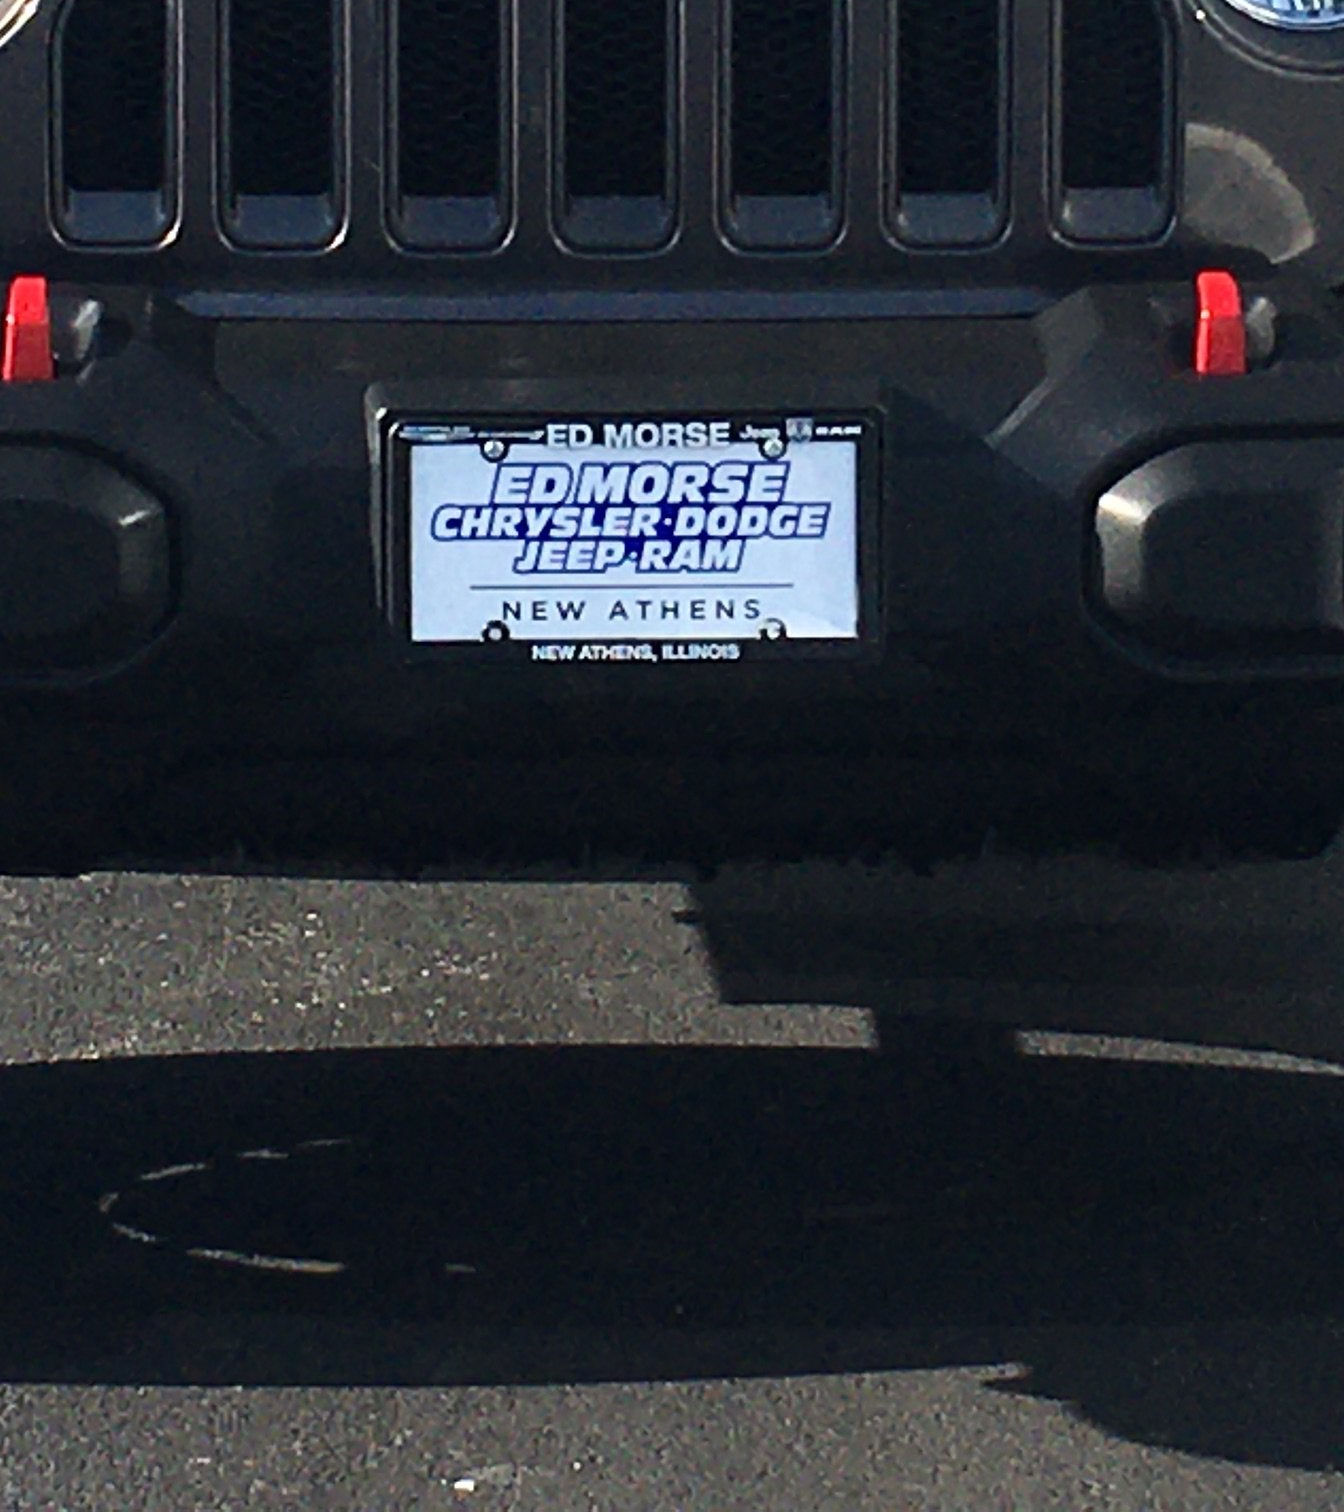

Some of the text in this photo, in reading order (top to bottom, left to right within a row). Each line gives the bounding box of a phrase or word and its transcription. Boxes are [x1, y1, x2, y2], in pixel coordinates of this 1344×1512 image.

[546, 421, 731, 449] ED MORSE
[491, 461, 790, 504] ED MORSE
[502, 598, 761, 621] NEW ATHENS
[531, 644, 576, 660] NEW
[661, 643, 741, 661] ILLINOIS
